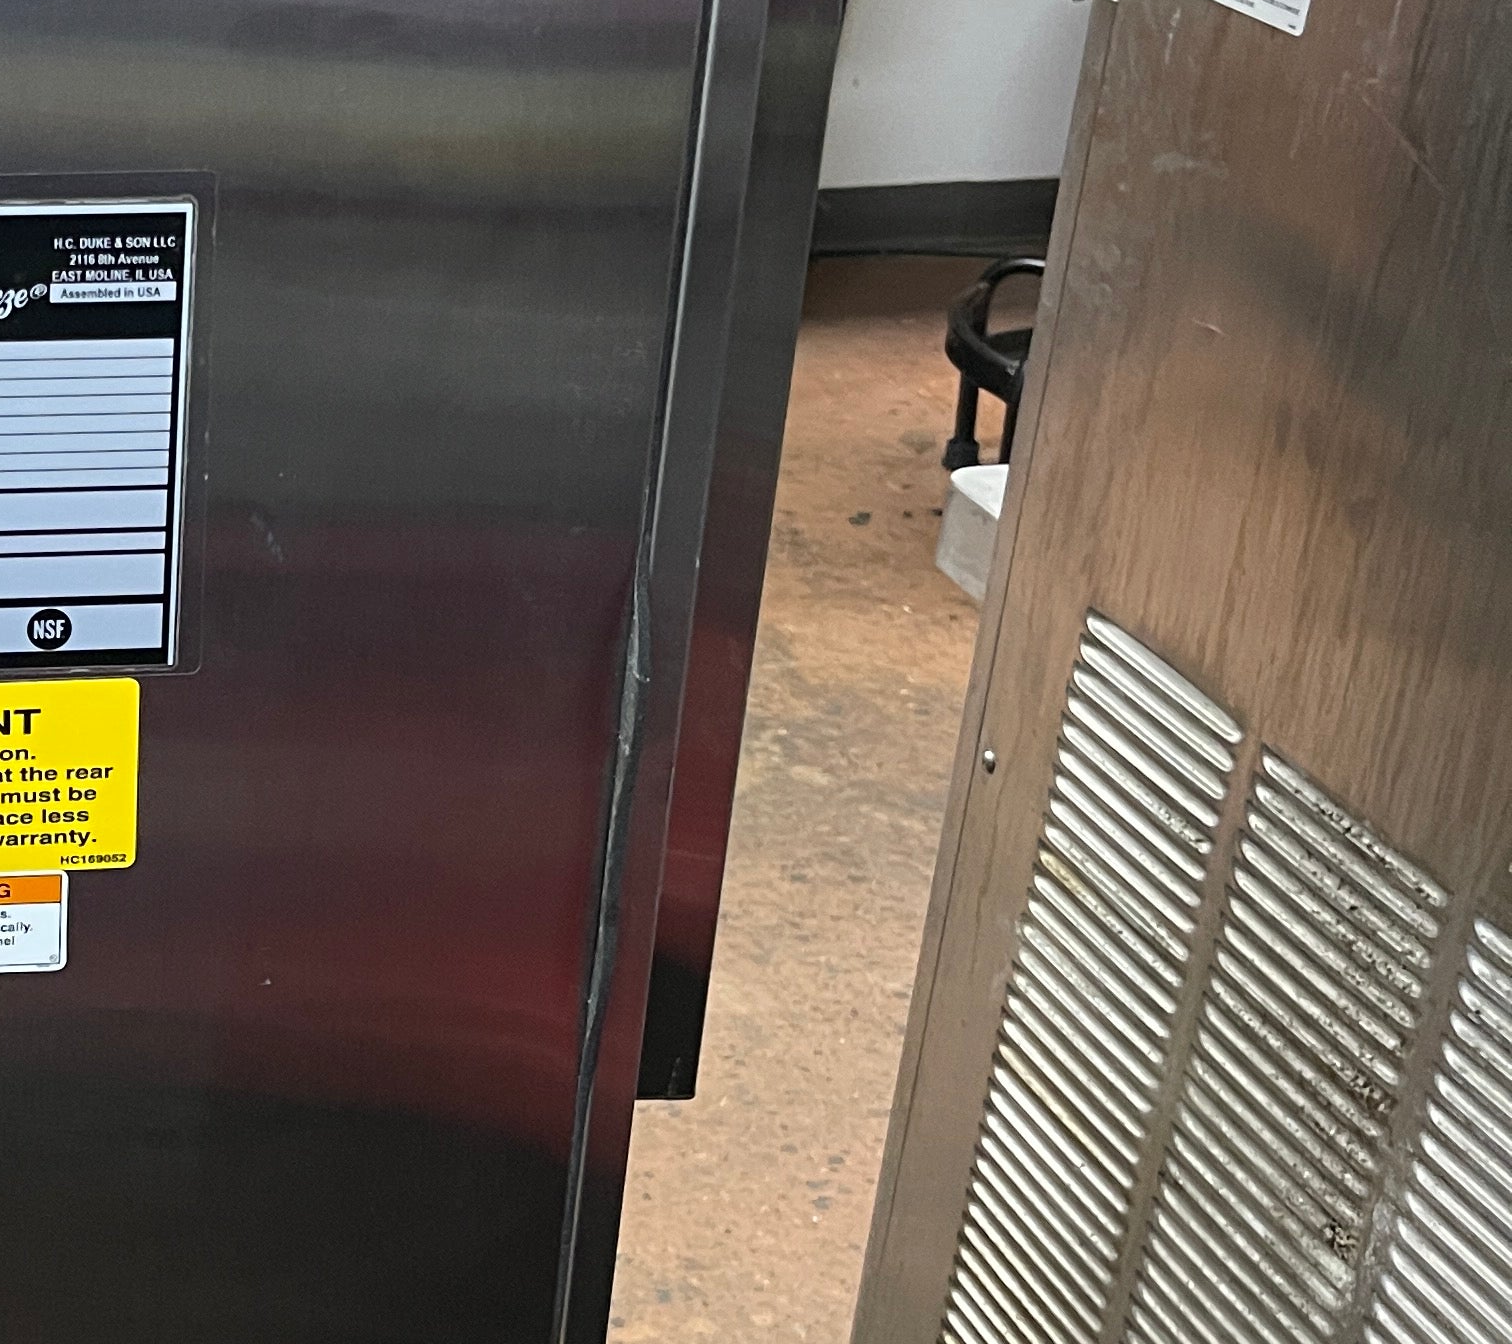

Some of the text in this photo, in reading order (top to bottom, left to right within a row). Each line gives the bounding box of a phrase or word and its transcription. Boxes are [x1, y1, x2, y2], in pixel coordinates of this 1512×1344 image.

[79, 237, 112, 249] DUKE
[114, 236, 123, 248] &
[126, 236, 152, 248] SON
[153, 236, 176, 248] LLC
[69, 254, 96, 266] 2116
[117, 253, 159, 265] Avenue
[51, 268, 174, 282] EAST MOLINE, IL USA
[60, 287, 161, 299] Assembled in USA
[33, 619, 65, 639] NSF
[20, 767, 58, 782] the
[66, 766, 114, 780] rear
[0, 787, 61, 804] must
[68, 786, 97, 801] be
[41, 808, 89, 824] less
